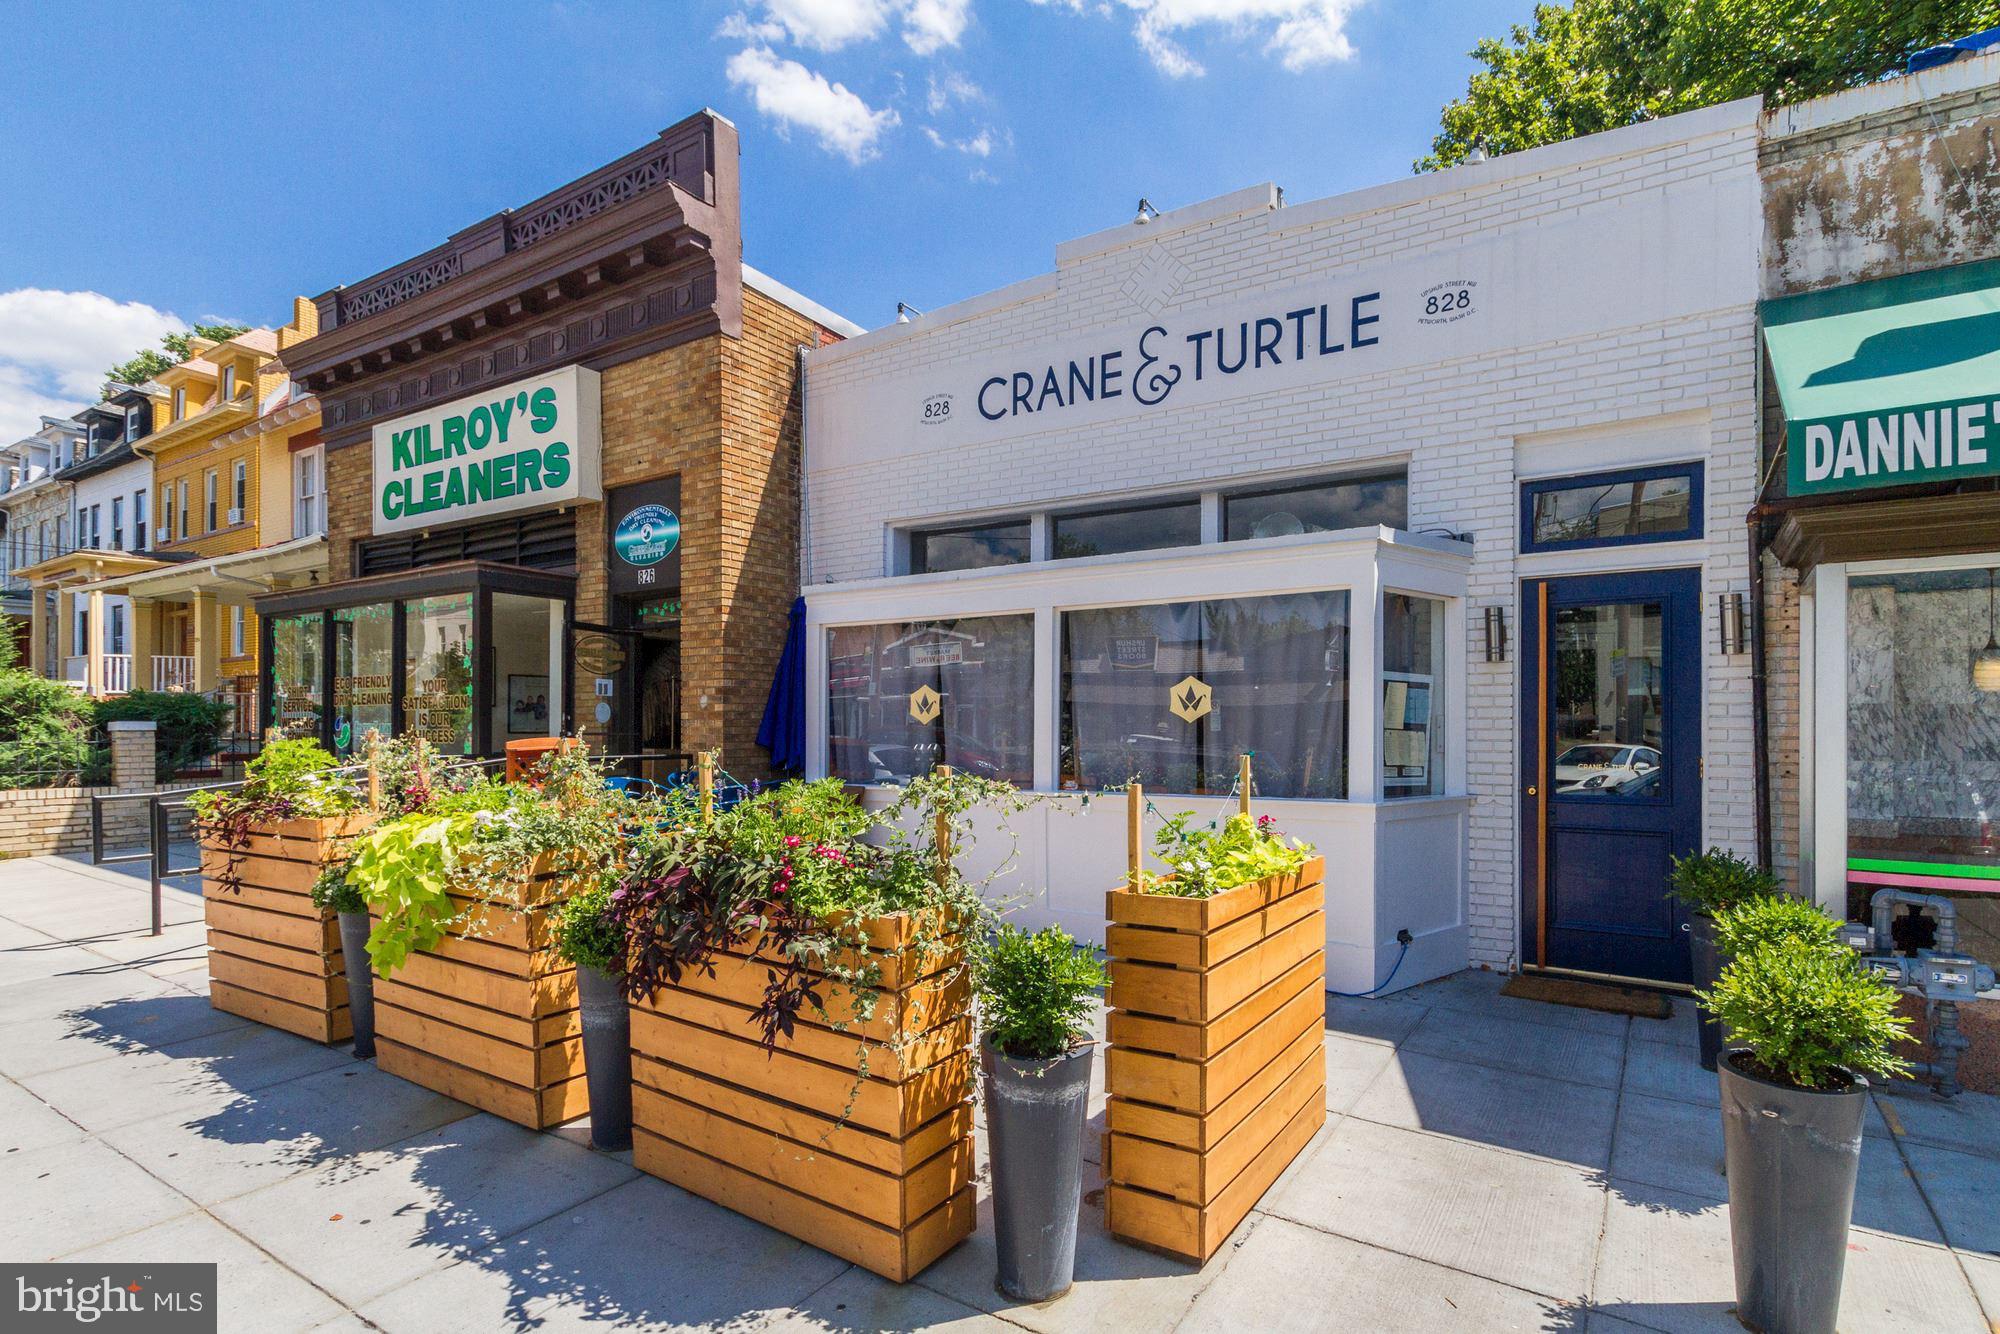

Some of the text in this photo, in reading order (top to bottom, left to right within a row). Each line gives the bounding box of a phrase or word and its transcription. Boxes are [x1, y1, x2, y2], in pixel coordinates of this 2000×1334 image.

[1445, 280, 1466, 288] STREET
[1425, 289, 1470, 315] 828
[977, 291, 1381, 421] CRANE & TURTLE
[924, 400, 950, 418] 828
[391, 386, 558, 472] KILROY'S
[382, 441, 571, 521] CLEANERS
[628, 517, 666, 532] DRY CLEANING
[638, 569, 655, 583] 826
[334, 675, 392, 690] ECO FRIENDLY
[422, 678, 448, 692] YOUR
[287, 686, 309, 698] SHIRT
[333, 692, 392, 707] DRY CLEANING
[282, 700, 314, 712] SERVICE
[402, 694, 469, 711] SATISFACTION
[418, 713, 451, 726] IS OUR
[1577, 762, 1603, 771] CRANE
